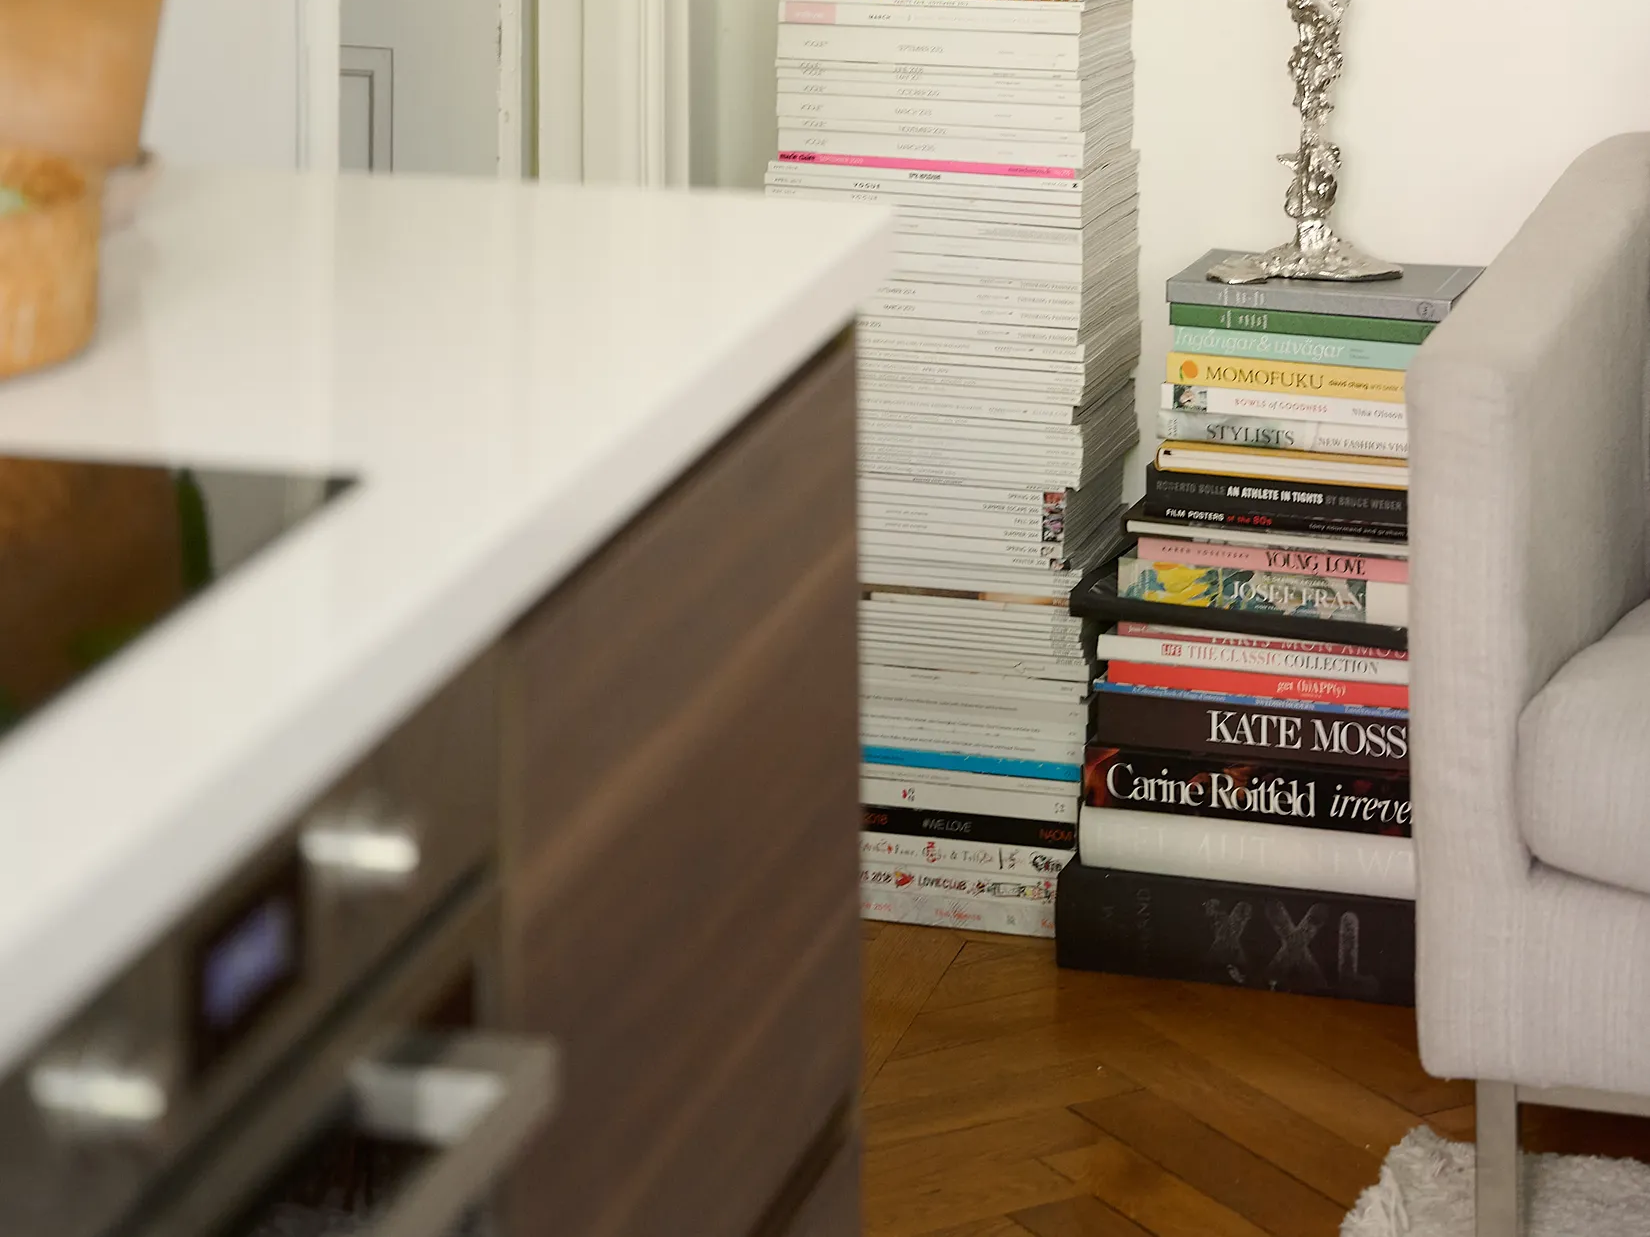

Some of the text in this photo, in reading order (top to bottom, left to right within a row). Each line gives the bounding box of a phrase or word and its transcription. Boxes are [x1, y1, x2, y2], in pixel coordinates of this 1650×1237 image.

[1174, 326, 1346, 361] Ingångar & utvägar
[1205, 365, 1324, 390] MOMOFUKU
[1206, 423, 1294, 445] STYLISTS
[1226, 485, 1240, 497] AN
[1241, 487, 1280, 501] ATHLETE
[1280, 490, 1291, 501] IN
[1292, 491, 1324, 505] TIGHTS
[1165, 508, 1186, 518] FILM
[1187, 510, 1225, 522] POSTERS
[1265, 551, 1366, 575] YOUNG LOVE
[1230, 581, 1295, 604] JOSEF
[1161, 643, 1379, 675] LIFE THE CLASSIC COLLECTION
[1277, 681, 1294, 694] get
[1205, 709, 1408, 759] KATE MOSS
[1106, 762, 1413, 825] Carine Roitfeld irreve
